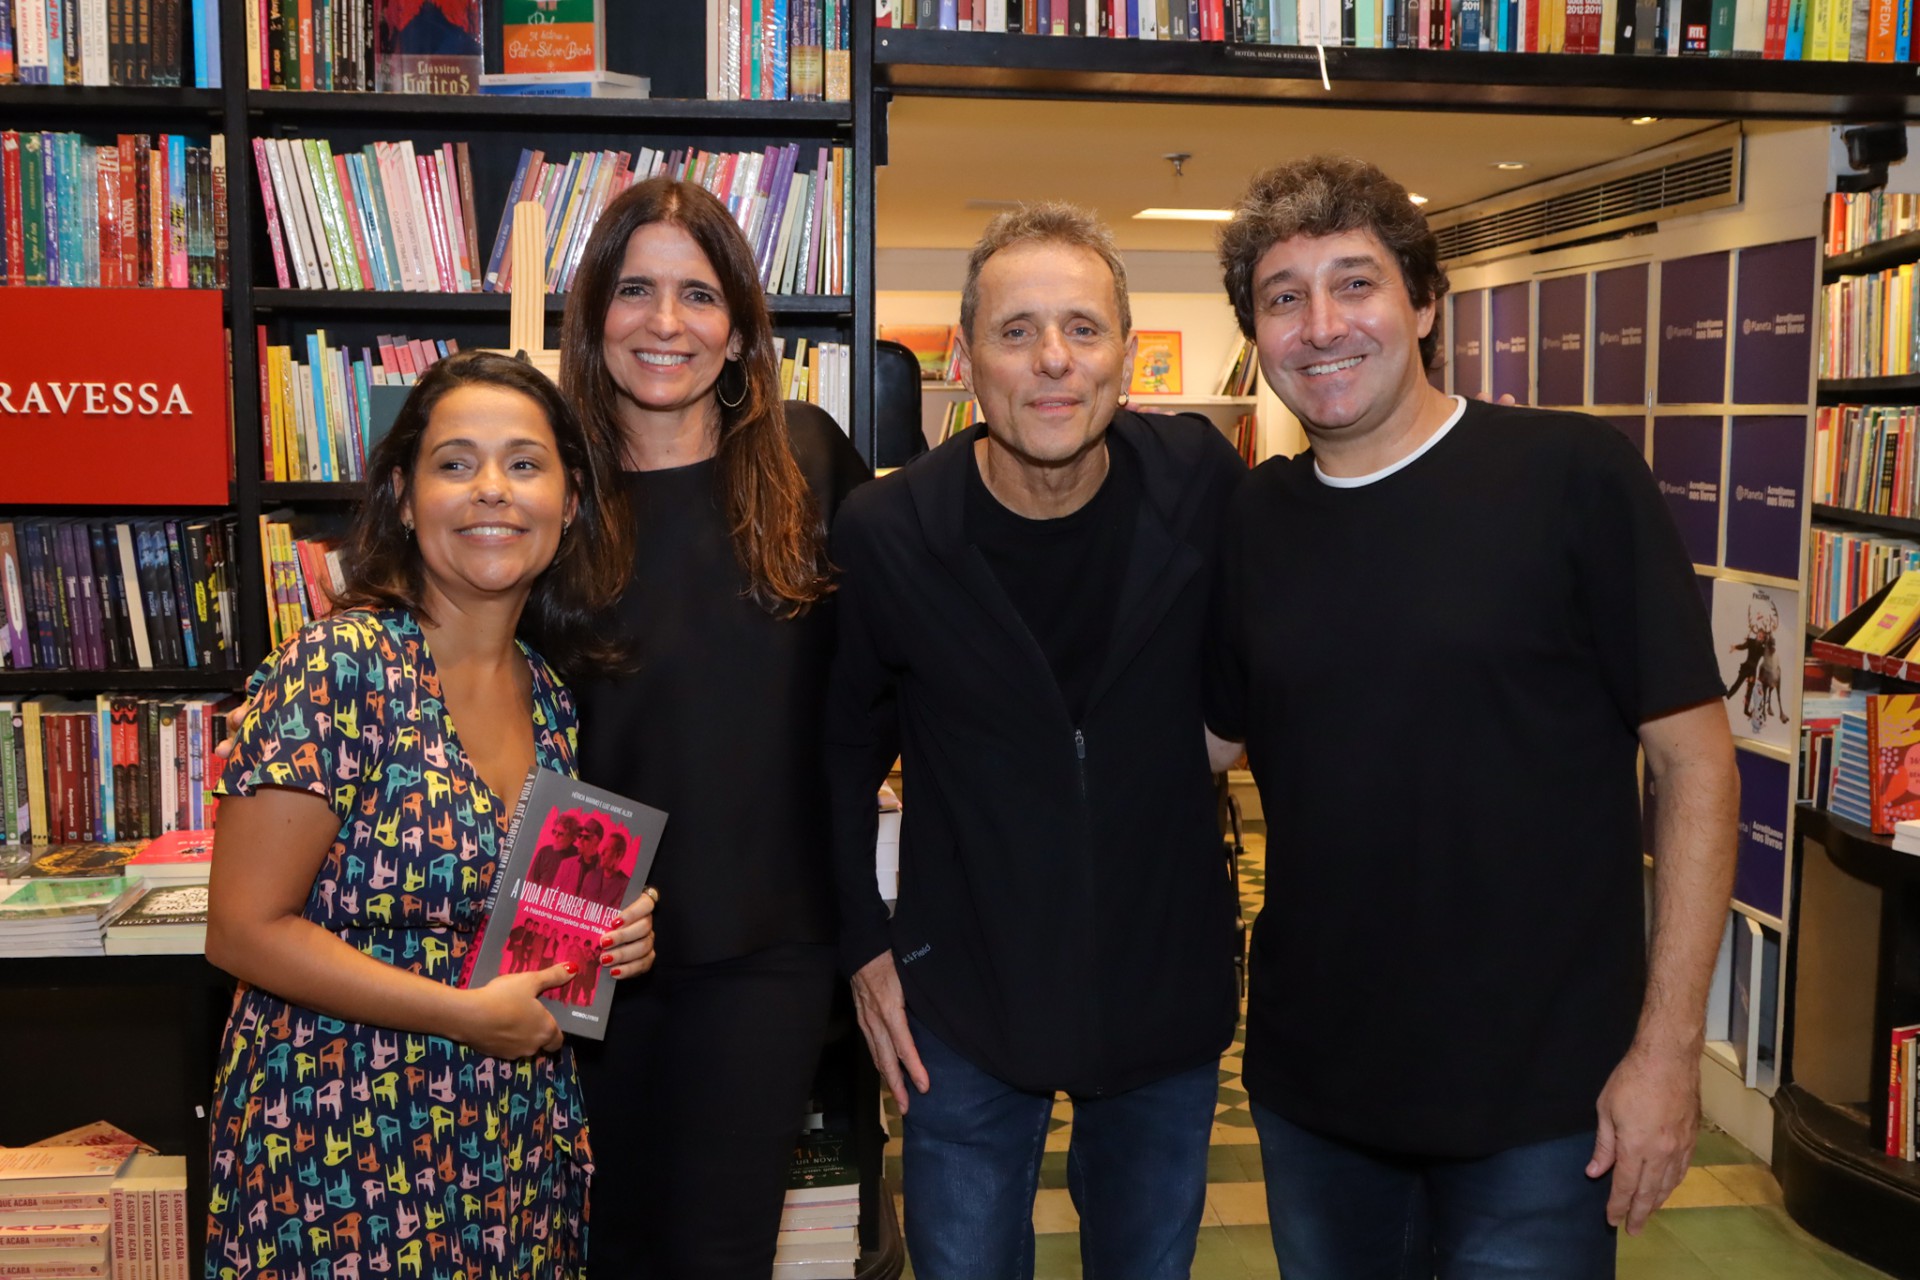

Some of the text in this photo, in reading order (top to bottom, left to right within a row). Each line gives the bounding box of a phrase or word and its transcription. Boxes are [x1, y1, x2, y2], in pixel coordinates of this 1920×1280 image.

[1462, 2, 1480, 11] 2011
[1567, 6, 1584, 14] 2012
[1585, 6, 1602, 14] 2011
[1688, 27, 1704, 39] RTL
[1752, 321, 1771, 331] Planeta
[1775, 323, 1804, 335] nos livros
[1744, 489, 1764, 500] Planeta
[178, 730, 187, 763] LADRÕES
[520, 782, 533, 801] VIDA
[515, 803, 525, 817] ATÉ
[504, 819, 520, 849] PARECE
[1752, 821, 1783, 839] Acreditamos
[1752, 830, 1783, 851] nos livros
[498, 850, 510, 869] UMA
[510, 878, 521, 899] A
[520, 880, 542, 905] VIDA
[540, 886, 560, 910] ATÉ
[555, 892, 586, 918] PARECE
[583, 900, 604, 924] UMA
[601, 906, 623, 928] FEST
[118, 918, 162, 926] HOLLY
[530, 906, 553, 919] história
[553, 915, 579, 927] completa
[114, 1199, 123, 1220] ASSIM
[127, 1200, 135, 1221] ASSIM
[160, 1200, 169, 1221] ASSIM
[174, 1200, 182, 1221] ASSIM
[115, 1222, 123, 1236] QUE
[160, 1223, 169, 1236] QUE
[175, 1223, 183, 1236] QUE
